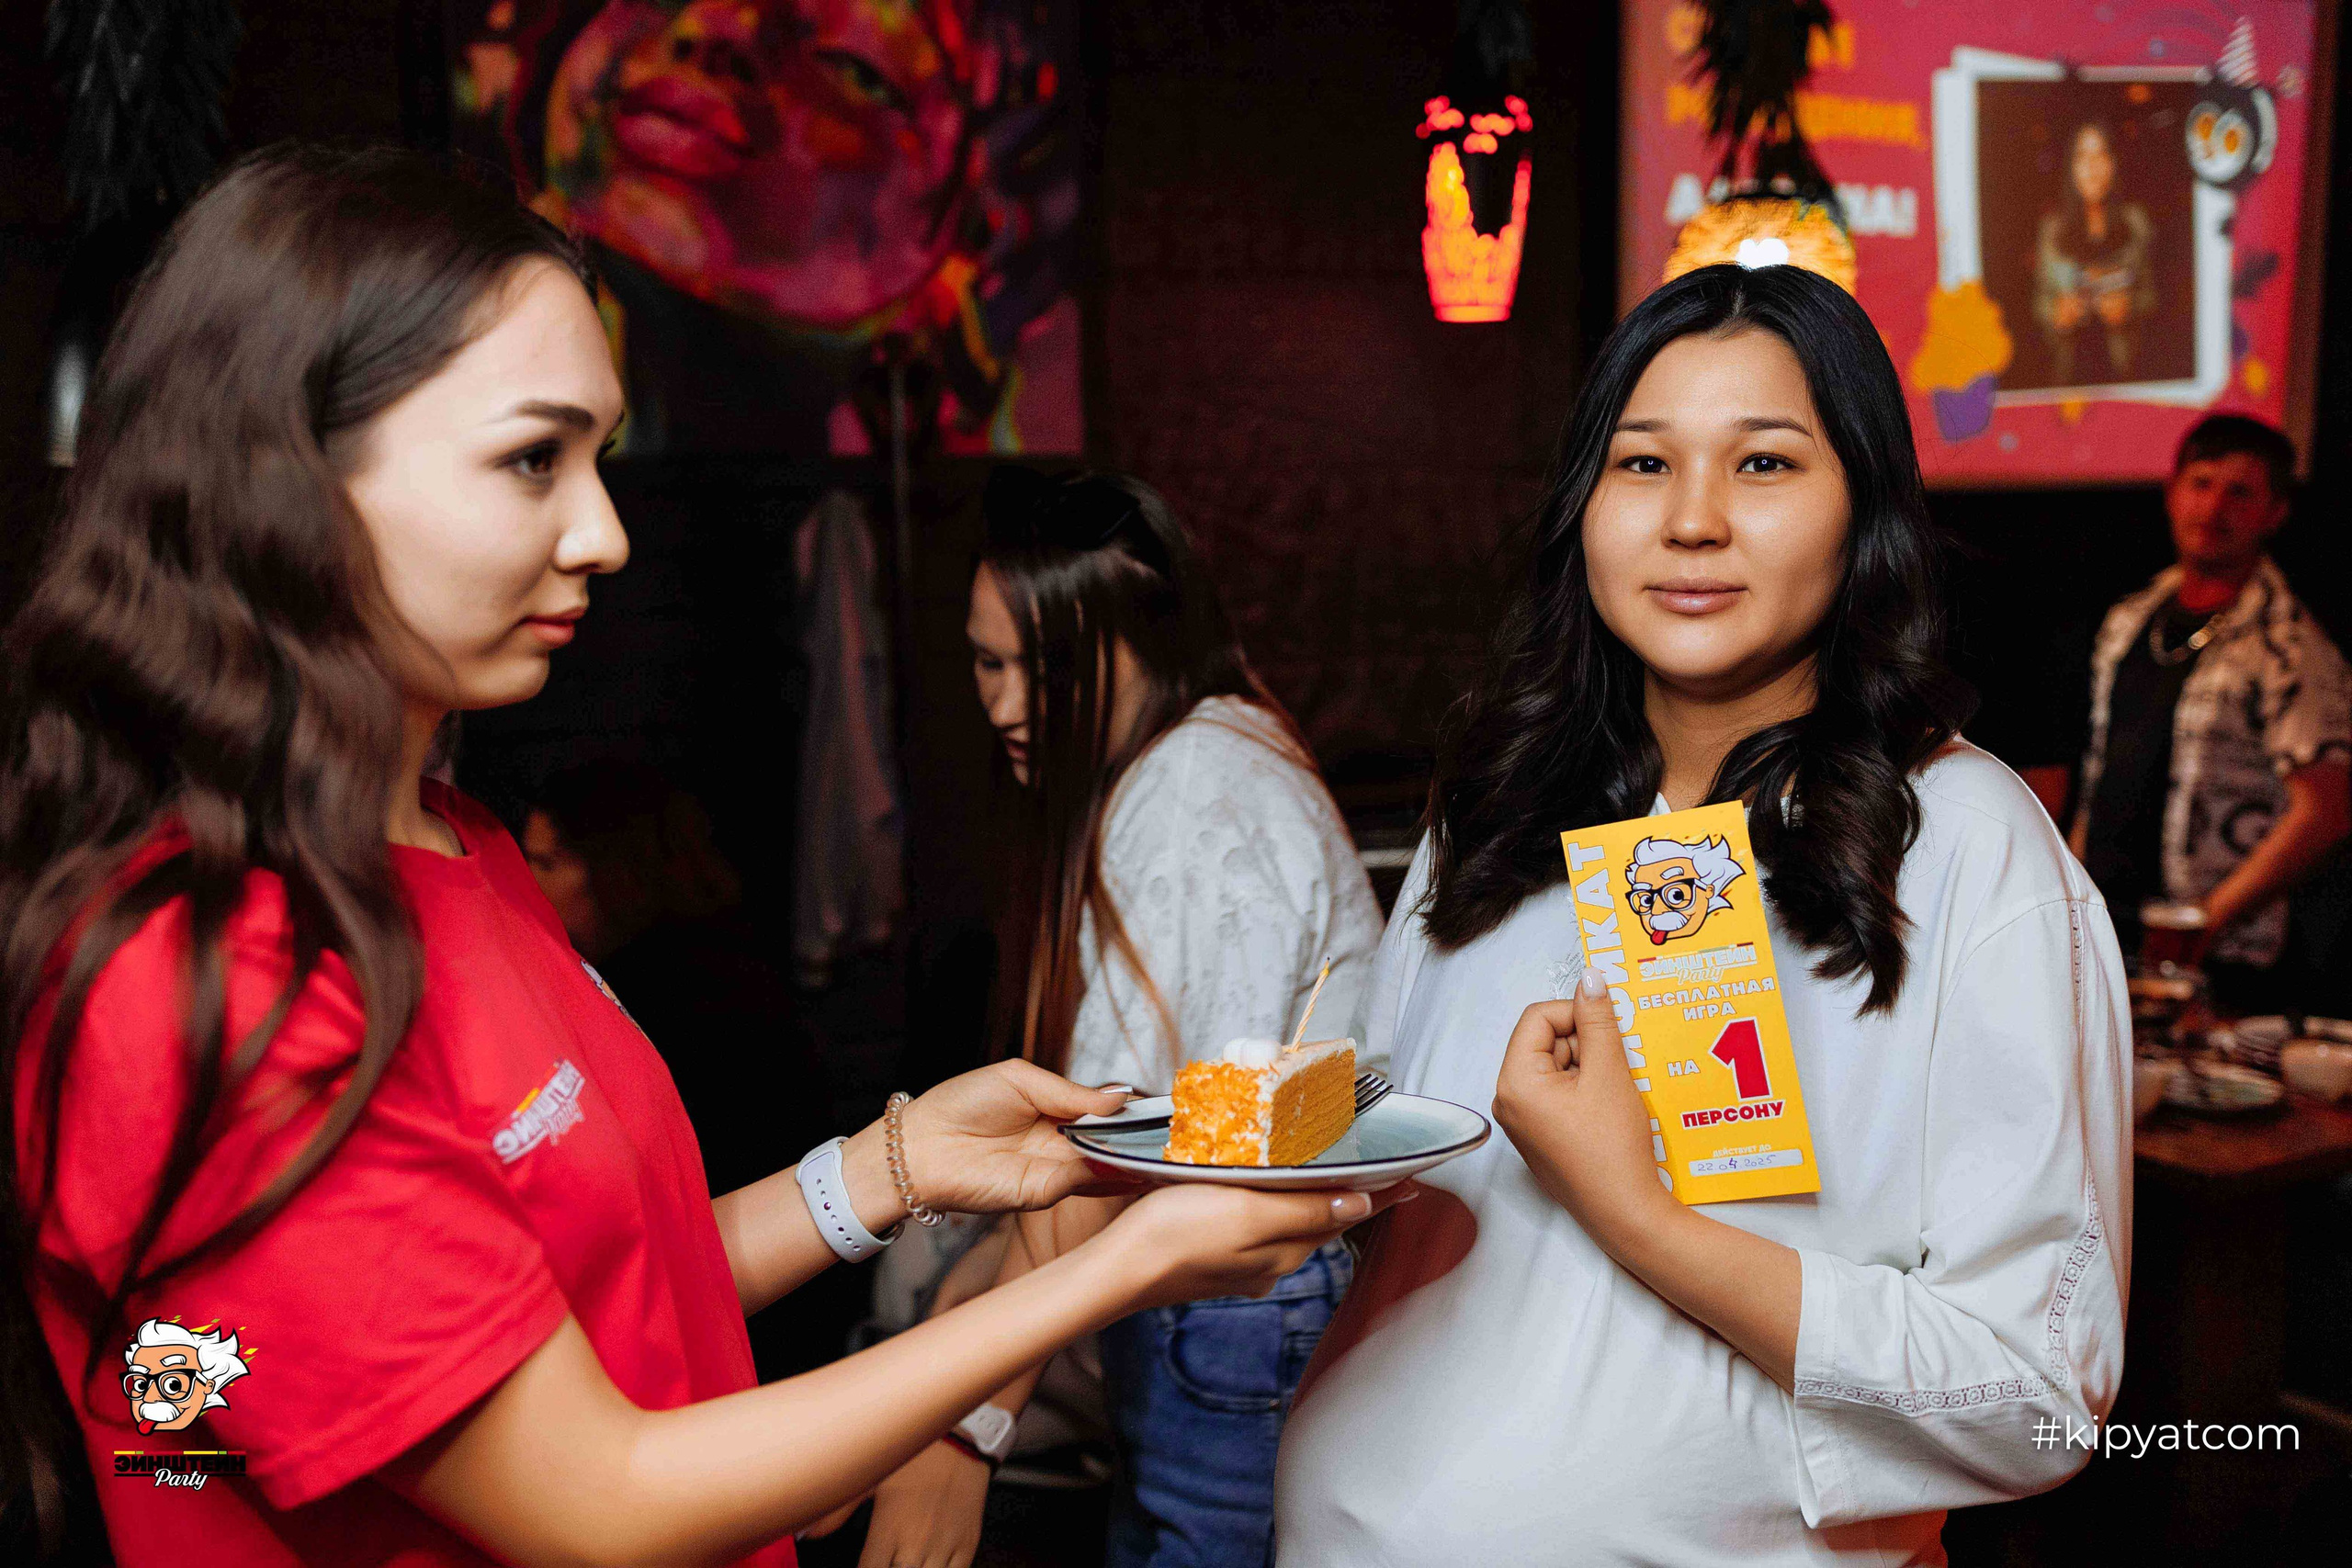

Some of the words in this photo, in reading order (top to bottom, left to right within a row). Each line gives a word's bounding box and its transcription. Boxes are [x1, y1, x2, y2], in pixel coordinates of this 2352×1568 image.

[1677, 966, 1724, 986] Party
[1637, 976, 1776, 1010] БЕСПЛАТНАЯ
[1683, 1001, 1737, 1021] ИГРА
[1667, 1059, 1701, 1077] НА
[1708, 1016, 1774, 1101] 1
[1680, 1099, 1786, 1130] ПЕРСОНУ
